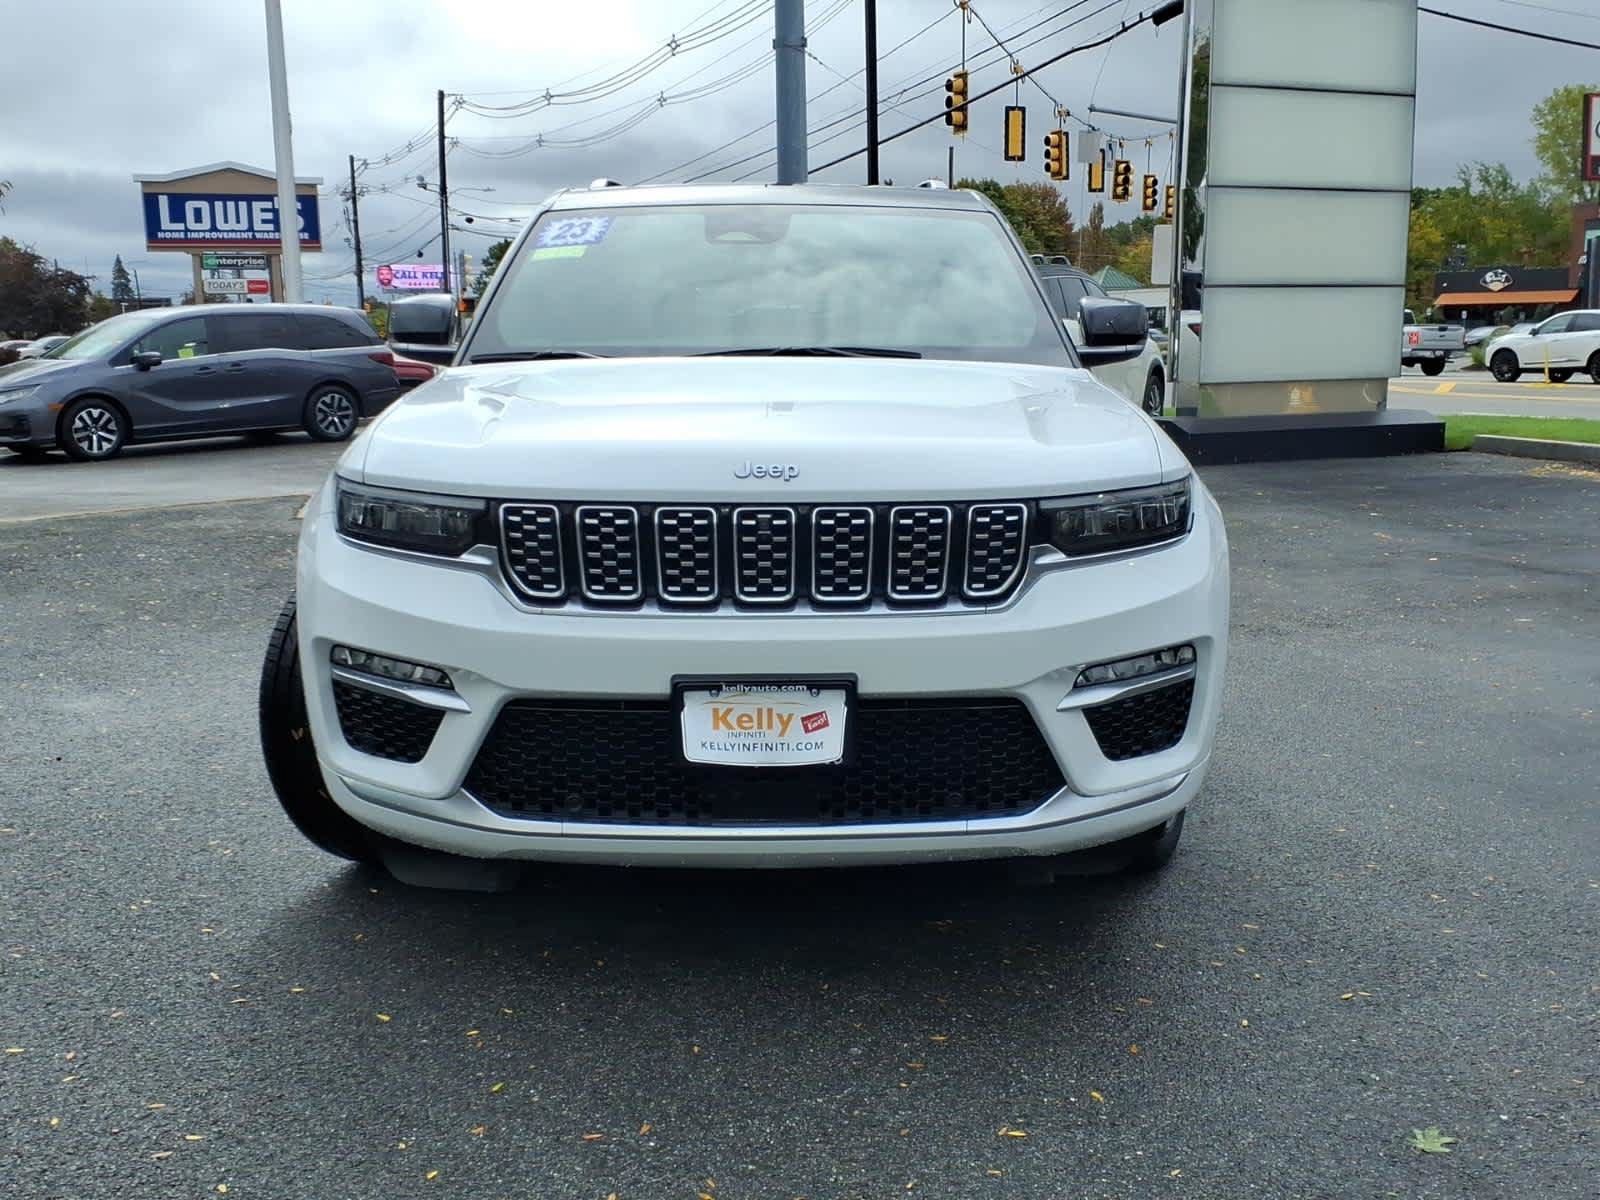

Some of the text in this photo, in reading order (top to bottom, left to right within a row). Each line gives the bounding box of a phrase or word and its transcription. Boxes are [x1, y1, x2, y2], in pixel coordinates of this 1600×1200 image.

[157, 231, 185, 239] HOME
[187, 231, 253, 240] IMPROVEMENT
[551, 221, 593, 241] 23
[206, 257, 265, 266] enterprise
[393, 271, 418, 279] CALL
[207, 281, 245, 289] TODAY'S
[735, 460, 800, 482] Jeep
[721, 682, 807, 693] kellyauto.com
[711, 706, 795, 738] Kelly
[727, 731, 766, 739] INFINITI
[700, 740, 824, 752] KELLYINFINITI.COM
